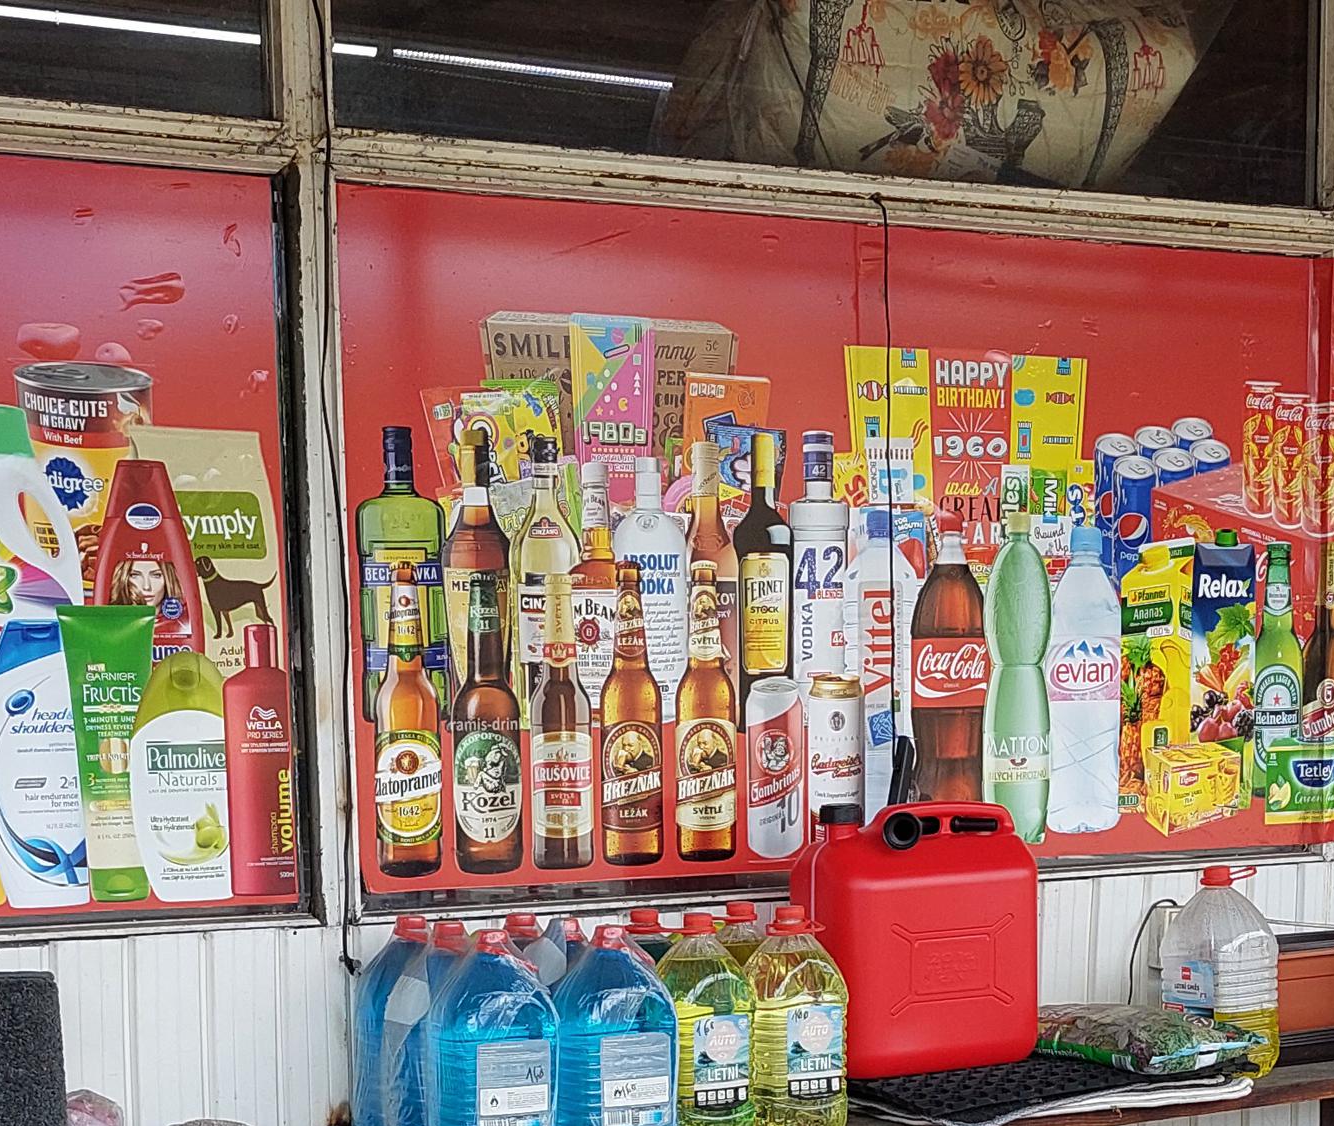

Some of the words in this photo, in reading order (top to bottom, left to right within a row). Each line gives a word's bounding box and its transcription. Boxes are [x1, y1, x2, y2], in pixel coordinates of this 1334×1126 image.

[934, 358, 1010, 388] HAPPY
[24, 391, 67, 416] CHOICE
[69, 399, 108, 418] CUTS
[936, 387, 1007, 409] BIRTHDAY!
[39, 413, 49, 427] IN
[50, 415, 86, 432] GRAVY
[44, 430, 63, 443] With
[64, 434, 83, 445] Beef
[581, 421, 649, 445] 1980s
[933, 434, 1008, 459] 1960
[811, 465, 827, 476] 42
[984, 479, 999, 498] A
[794, 546, 844, 601] 42
[1197, 573, 1249, 599] Relax
[749, 605, 780, 615] STOCK
[1132, 605, 1164, 621] Ananas
[749, 617, 780, 626] CITRUS
[800, 602, 815, 661] VODKA
[916, 642, 987, 681] Coca-Cola
[85, 672, 137, 682] GARNIER
[1054, 658, 1115, 684] evian
[31, 707, 68, 721] head
[1255, 711, 1299, 726] Heineken
[9, 720, 75, 736] shoulders
[245, 720, 283, 731] WELLA
[246, 731, 261, 739] PRO
[146, 745, 227, 771] Palmolive
[157, 772, 218, 787] Naturals
[24, 793, 40, 801] hair
[461, 790, 517, 813] Kozel
[276, 768, 293, 855] volume
[398, 804, 421, 818] 1642
[619, 807, 648, 819] LEŽÁK
[800, 1053, 832, 1072] LETNÍ
[707, 1065, 740, 1083] LETNÍ
